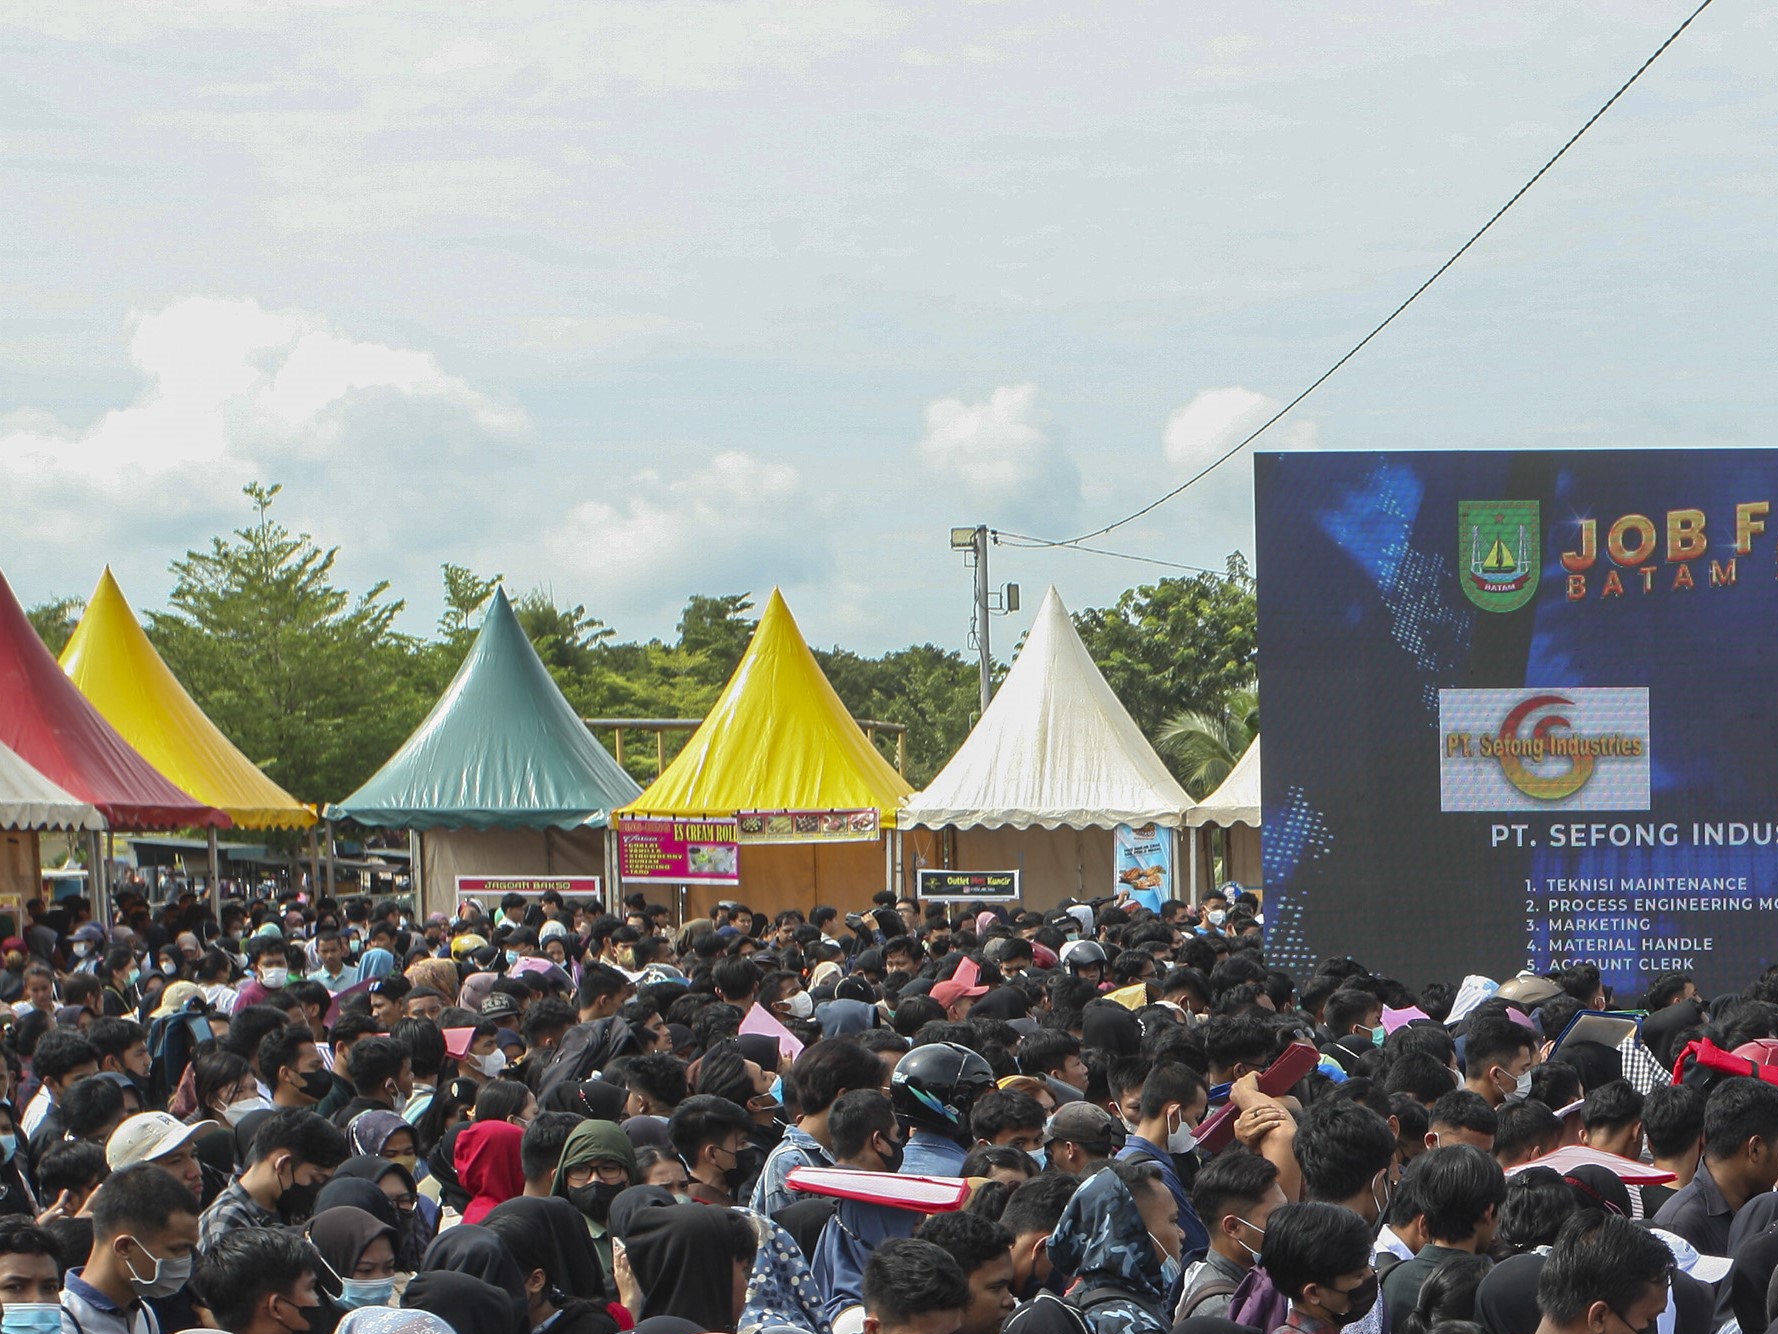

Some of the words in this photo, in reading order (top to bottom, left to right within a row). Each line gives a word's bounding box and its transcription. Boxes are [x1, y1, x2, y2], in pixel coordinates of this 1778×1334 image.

[1560, 508, 1708, 572] JOB
[1483, 582, 1517, 593] BATAM
[1566, 558, 1738, 601] BATAM
[1446, 733, 1475, 758] PT.
[1480, 732, 1545, 763] Sefong
[1550, 731, 1643, 758] Industries
[674, 824, 684, 842] ES
[685, 823, 714, 842] CREAM
[1491, 824, 1537, 848] PT.
[1549, 822, 1679, 847] SEFONG
[532, 881, 571, 890] BAKSO
[947, 876, 970, 886] Outlet
[1524, 879, 1537, 892] 1.
[1547, 878, 1615, 892] TEKNISI
[1621, 876, 1748, 892] MAINTENANCE
[1525, 900, 1540, 913] 2.
[1548, 899, 1628, 912] PROCESS
[1634, 897, 1753, 912] ENGINEERING
[1526, 919, 1540, 932] 3.
[1548, 918, 1651, 932] MARKETING
[1526, 939, 1542, 952] 4.
[1548, 938, 1636, 952] MATERIAL
[1642, 937, 1714, 951] HANDLE
[1526, 959, 1540, 972] 5.
[1639, 957, 1695, 971] CLERK
